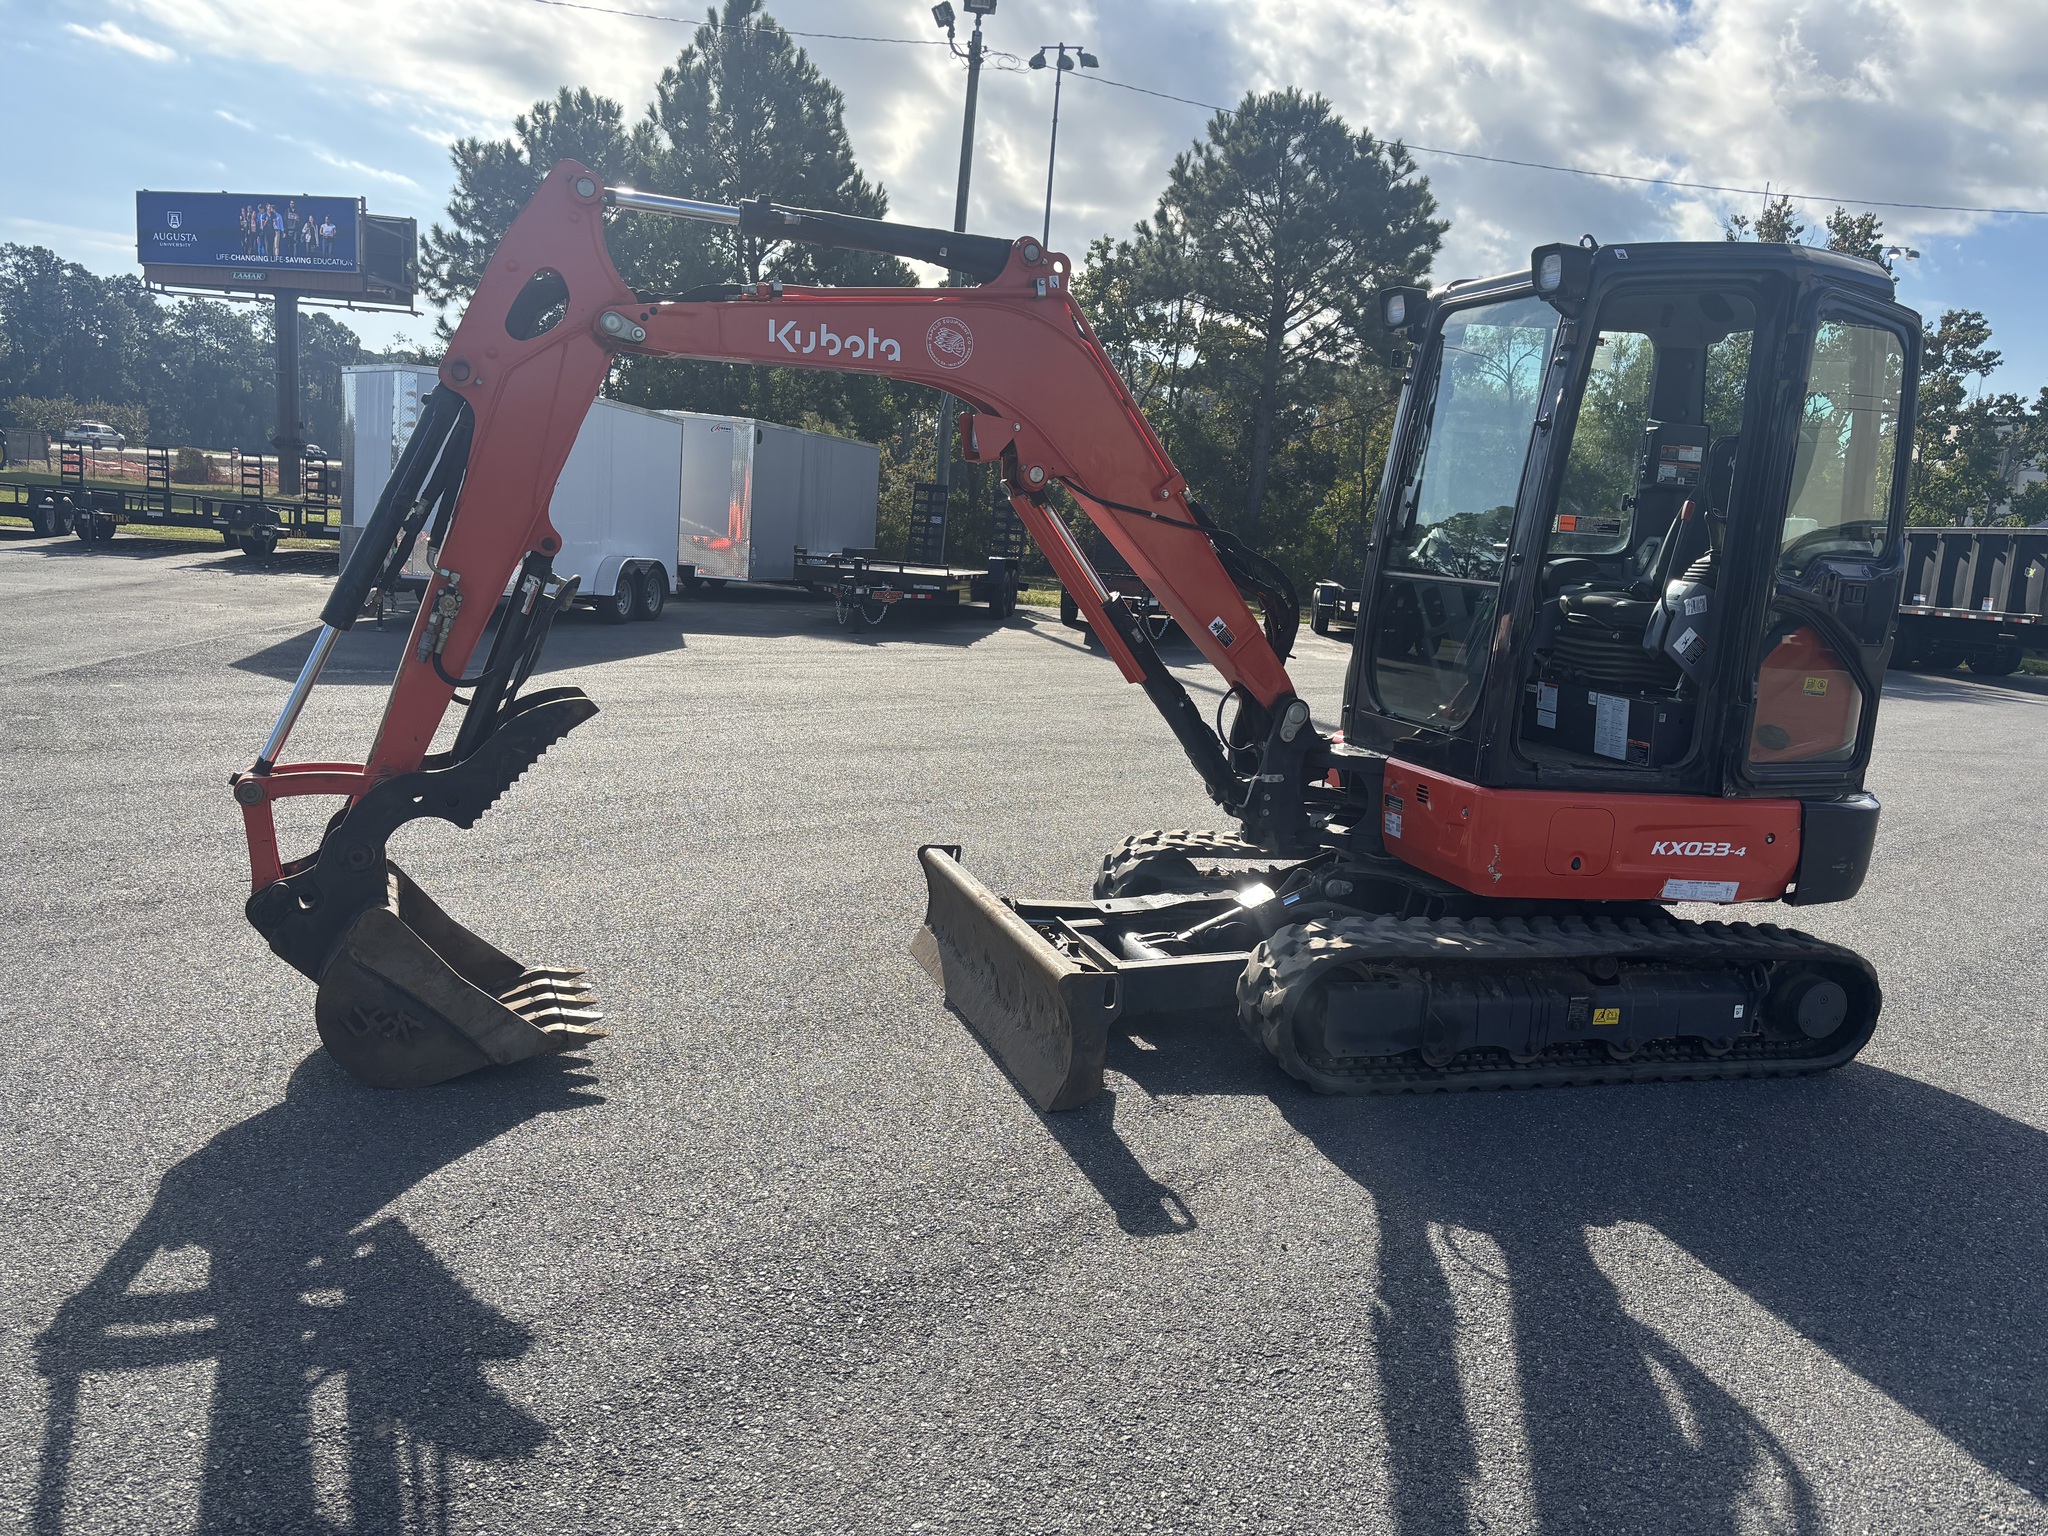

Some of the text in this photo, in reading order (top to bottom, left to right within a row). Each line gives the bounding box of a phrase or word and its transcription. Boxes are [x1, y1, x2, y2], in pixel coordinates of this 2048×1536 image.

[152, 232, 198, 242] AUGUSTA
[215, 253, 353, 267] LIFE-CHANGING LIFE-SAVING EDUCATION
[233, 271, 263, 280] LAMAR
[942, 318, 970, 336] EQUIPMENT
[768, 318, 901, 362] Kubota
[111, 514, 130, 523] LINX
[290, 529, 308, 538] LINX
[1651, 841, 1747, 857] KX033-4
[337, 1006, 427, 1041] USA
